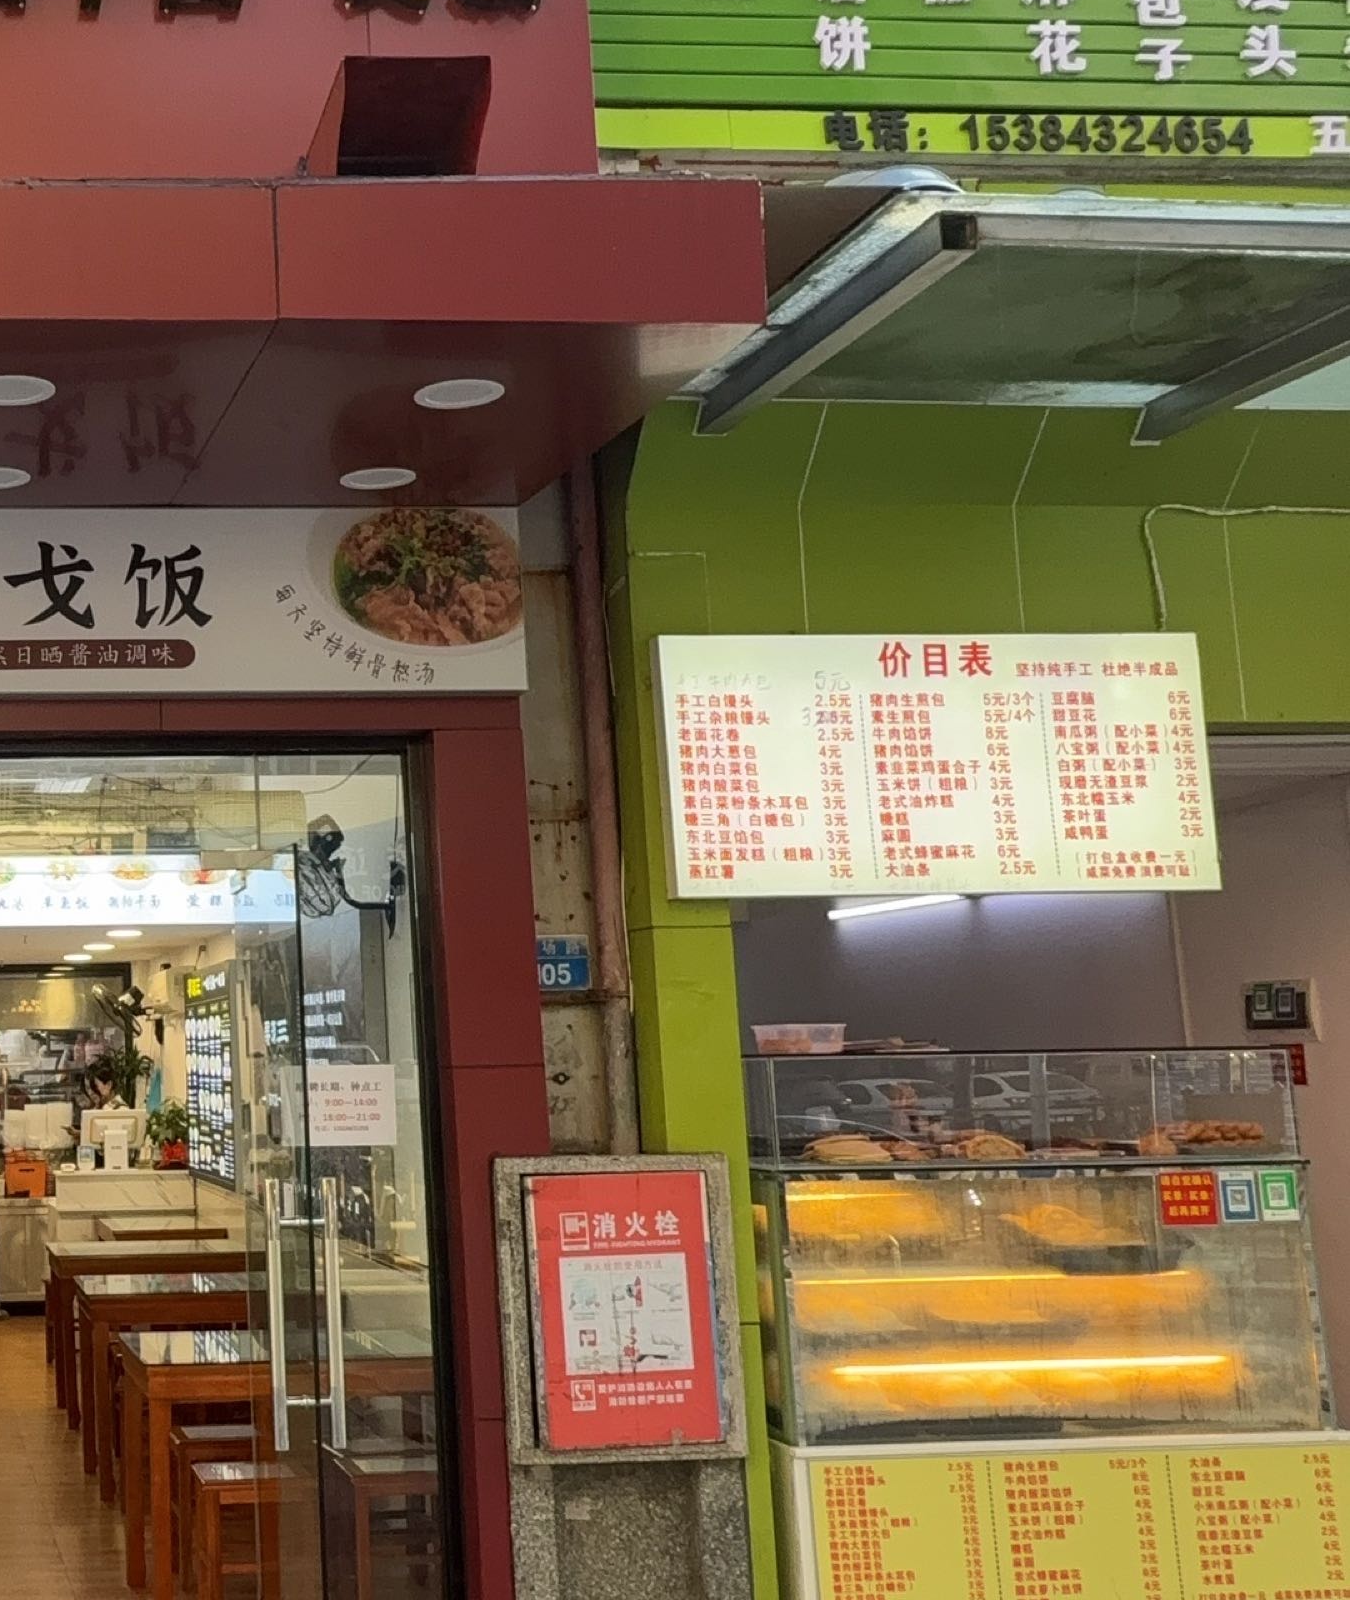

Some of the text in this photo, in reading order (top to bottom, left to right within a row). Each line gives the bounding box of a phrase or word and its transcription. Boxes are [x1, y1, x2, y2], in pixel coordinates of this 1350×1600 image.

[959, 112, 1254, 156] 15384324654
[878, 641, 993, 679] 价目表
[1016, 662, 1179, 678] 坚持纯手工 杜绝半成品
[815, 694, 852, 707] 2.5元
[983, 692, 1034, 706] 5元/3个
[1167, 690, 1190, 705] 6元
[984, 709, 1035, 723] 5元/4个
[1169, 707, 1192, 721] 6元
[817, 728, 855, 741] 2.5元
[985, 726, 1009, 740] 8元
[1170, 723, 1194, 737] 4元
[819, 745, 842, 759] 4元
[986, 743, 1010, 757] 6元
[1172, 740, 1196, 754] 4元
[820, 762, 844, 775] 3元
[988, 760, 1011, 774] 4元
[1174, 757, 1197, 771] 3元
[821, 779, 845, 792] 3元
[990, 777, 1013, 791] 3元
[1176, 774, 1199, 787] 2元
[822, 796, 846, 810] 3元
[992, 794, 1015, 807] 4元
[1178, 790, 1201, 804] 4元
[824, 813, 848, 827] 3元
[993, 811, 1017, 824] 3元
[1179, 807, 1202, 821] 2元
[826, 830, 850, 844] 3元
[996, 827, 1019, 841] 3元
[1181, 824, 1204, 837] 3元
[828, 847, 852, 861] 3元
[997, 845, 1021, 858] 6元
[829, 864, 853, 879] 3元
[999, 861, 1036, 875] 2.5元
[592, 1209, 680, 1239] 消火栓
